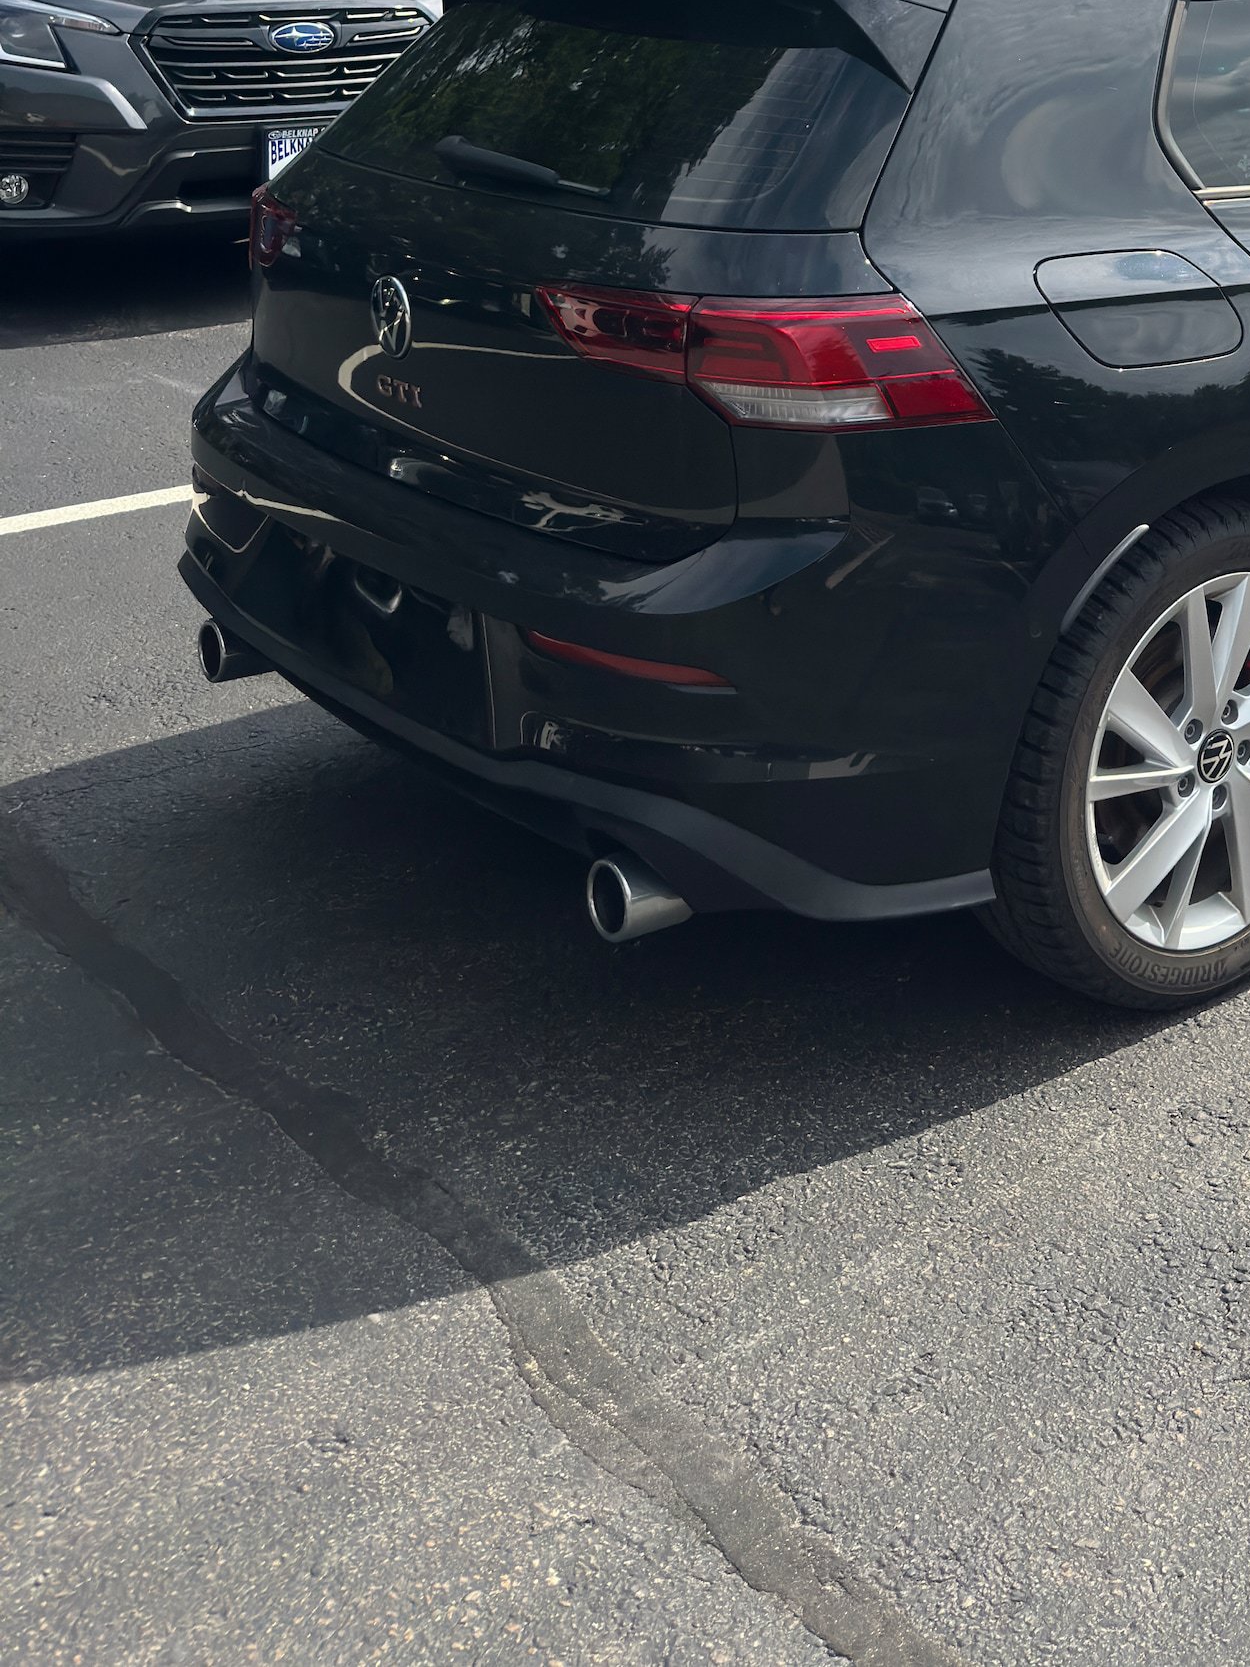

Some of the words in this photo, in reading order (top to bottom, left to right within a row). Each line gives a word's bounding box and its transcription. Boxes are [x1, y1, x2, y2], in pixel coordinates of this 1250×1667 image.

[282, 127, 319, 138] BELKNAP
[271, 138, 313, 165] BELKN
[377, 374, 422, 408] GTI
[1109, 941, 1228, 985] BRIDGESTONE
